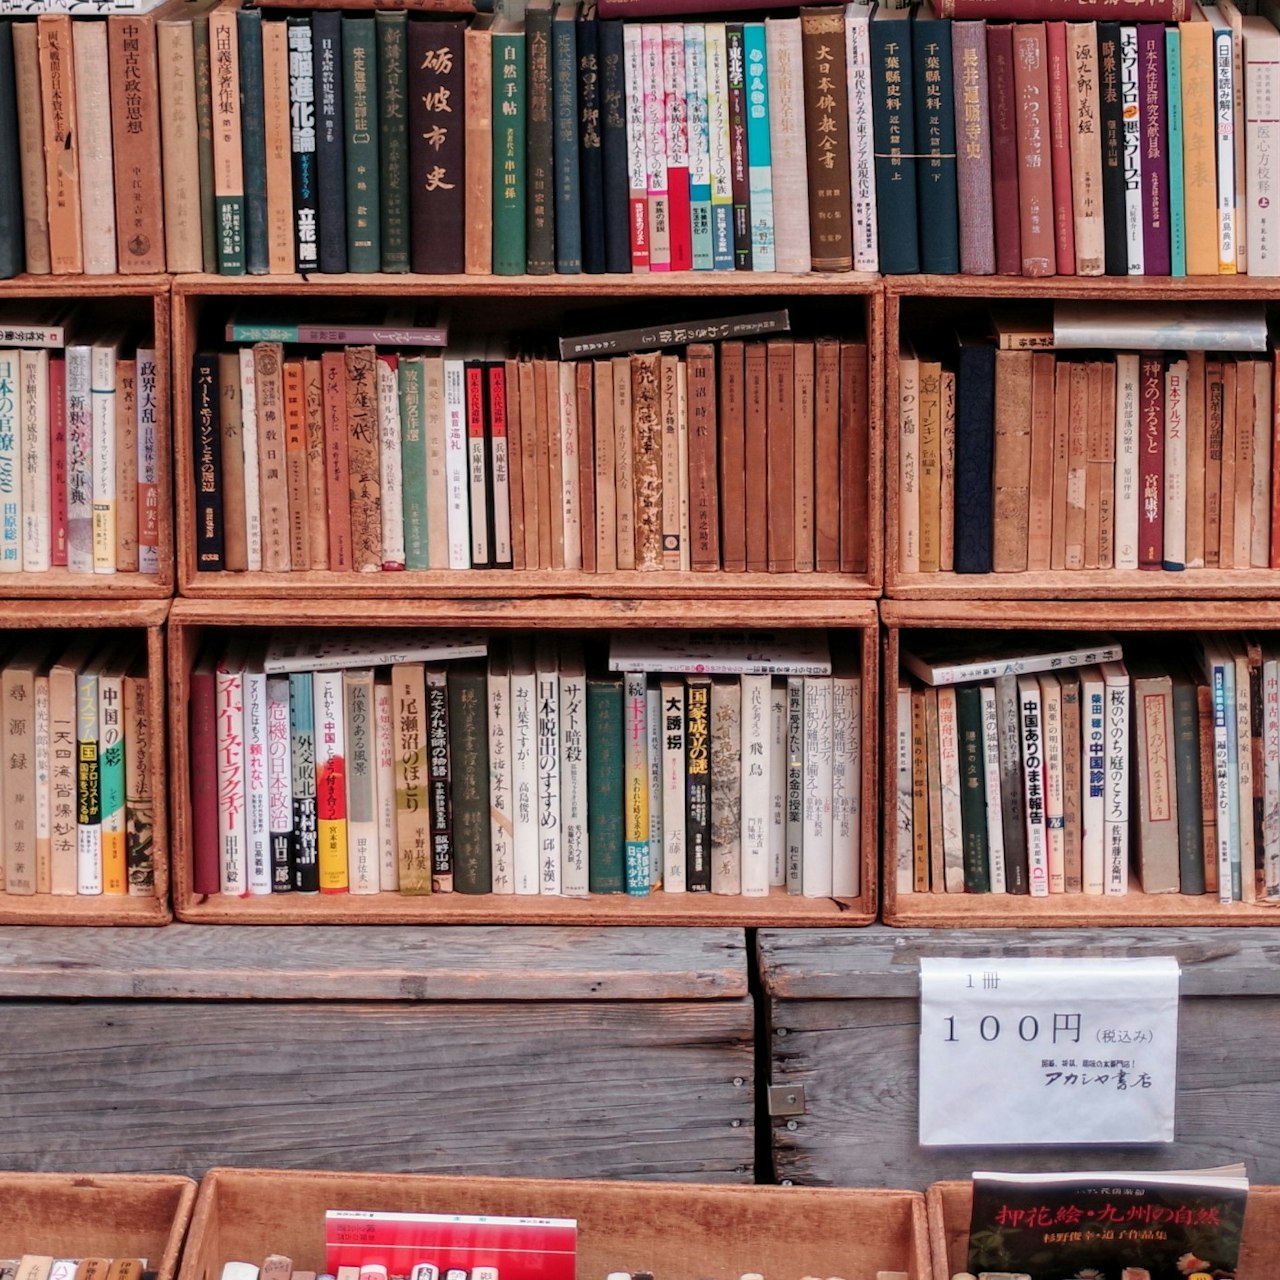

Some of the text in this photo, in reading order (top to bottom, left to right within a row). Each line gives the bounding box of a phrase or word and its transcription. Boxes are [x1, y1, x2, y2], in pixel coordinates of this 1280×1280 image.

[288, 25, 316, 153] 電脳進化論
[502, 45, 517, 116] 自然手帖
[298, 208, 318, 261] 立花隆
[694, 367, 707, 438] 田沼時代
[1144, 361, 1160, 454] 神々のふるさと
[1169, 376, 1181, 440] 日本アルプス
[269, 702, 289, 830] 危機の日本政治
[352, 687, 366, 776] 仏像のある風景
[539, 681, 557, 829] 日本脱出のすすめ
[666, 697, 682, 750] 大誘拐
[688, 687, 708, 775] 国家成立の謎
[1024, 700, 1043, 825] 中国ありのまま報告
[1044, 1070, 1152, 1090] アカシヤ書店
